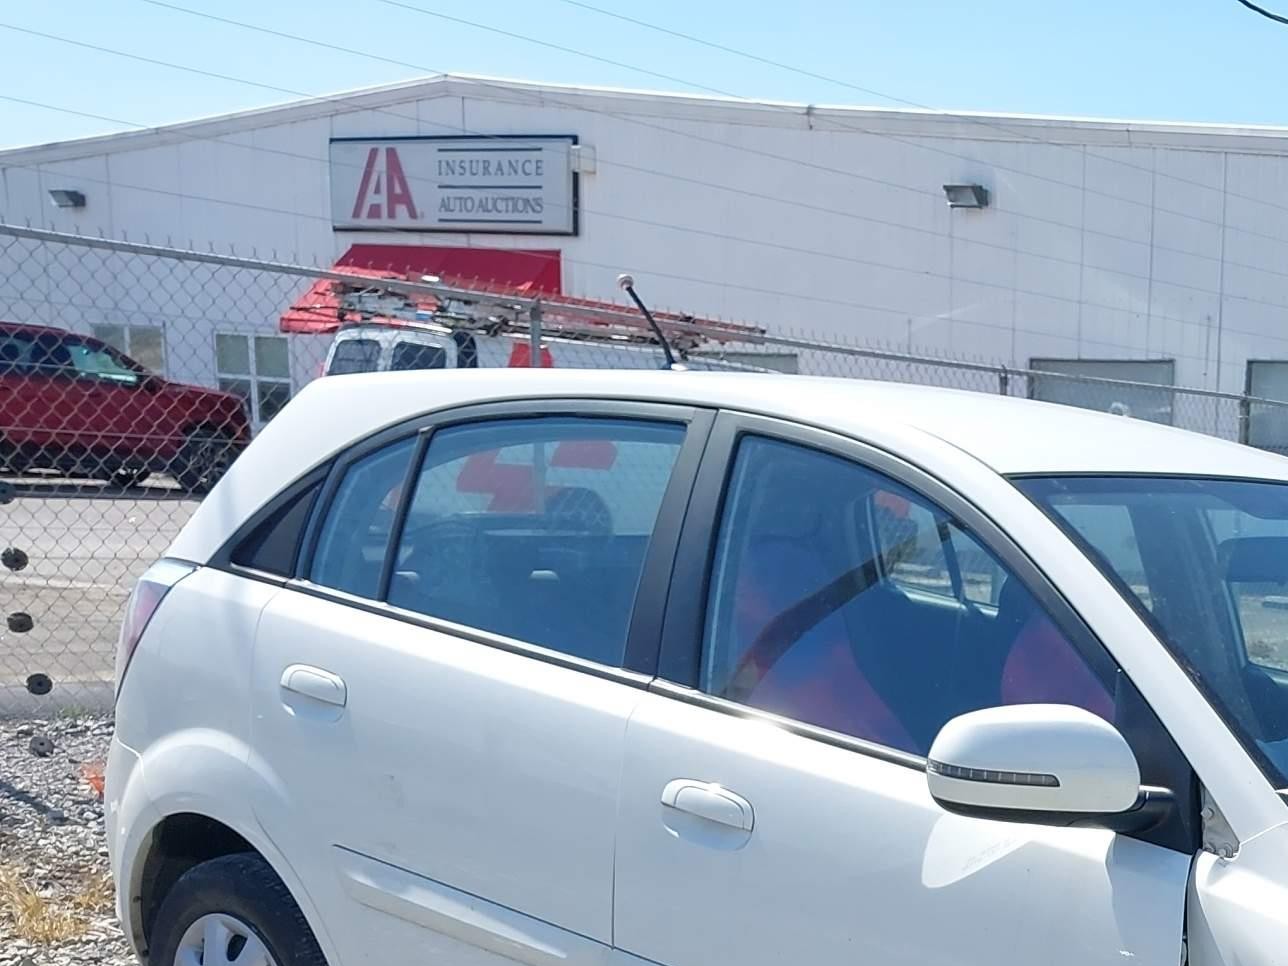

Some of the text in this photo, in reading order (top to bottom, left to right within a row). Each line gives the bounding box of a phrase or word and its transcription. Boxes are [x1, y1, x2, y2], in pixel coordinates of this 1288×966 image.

[438, 159, 544, 176] INSURANCE
[438, 196, 544, 214] AUTO AUCTIONS
